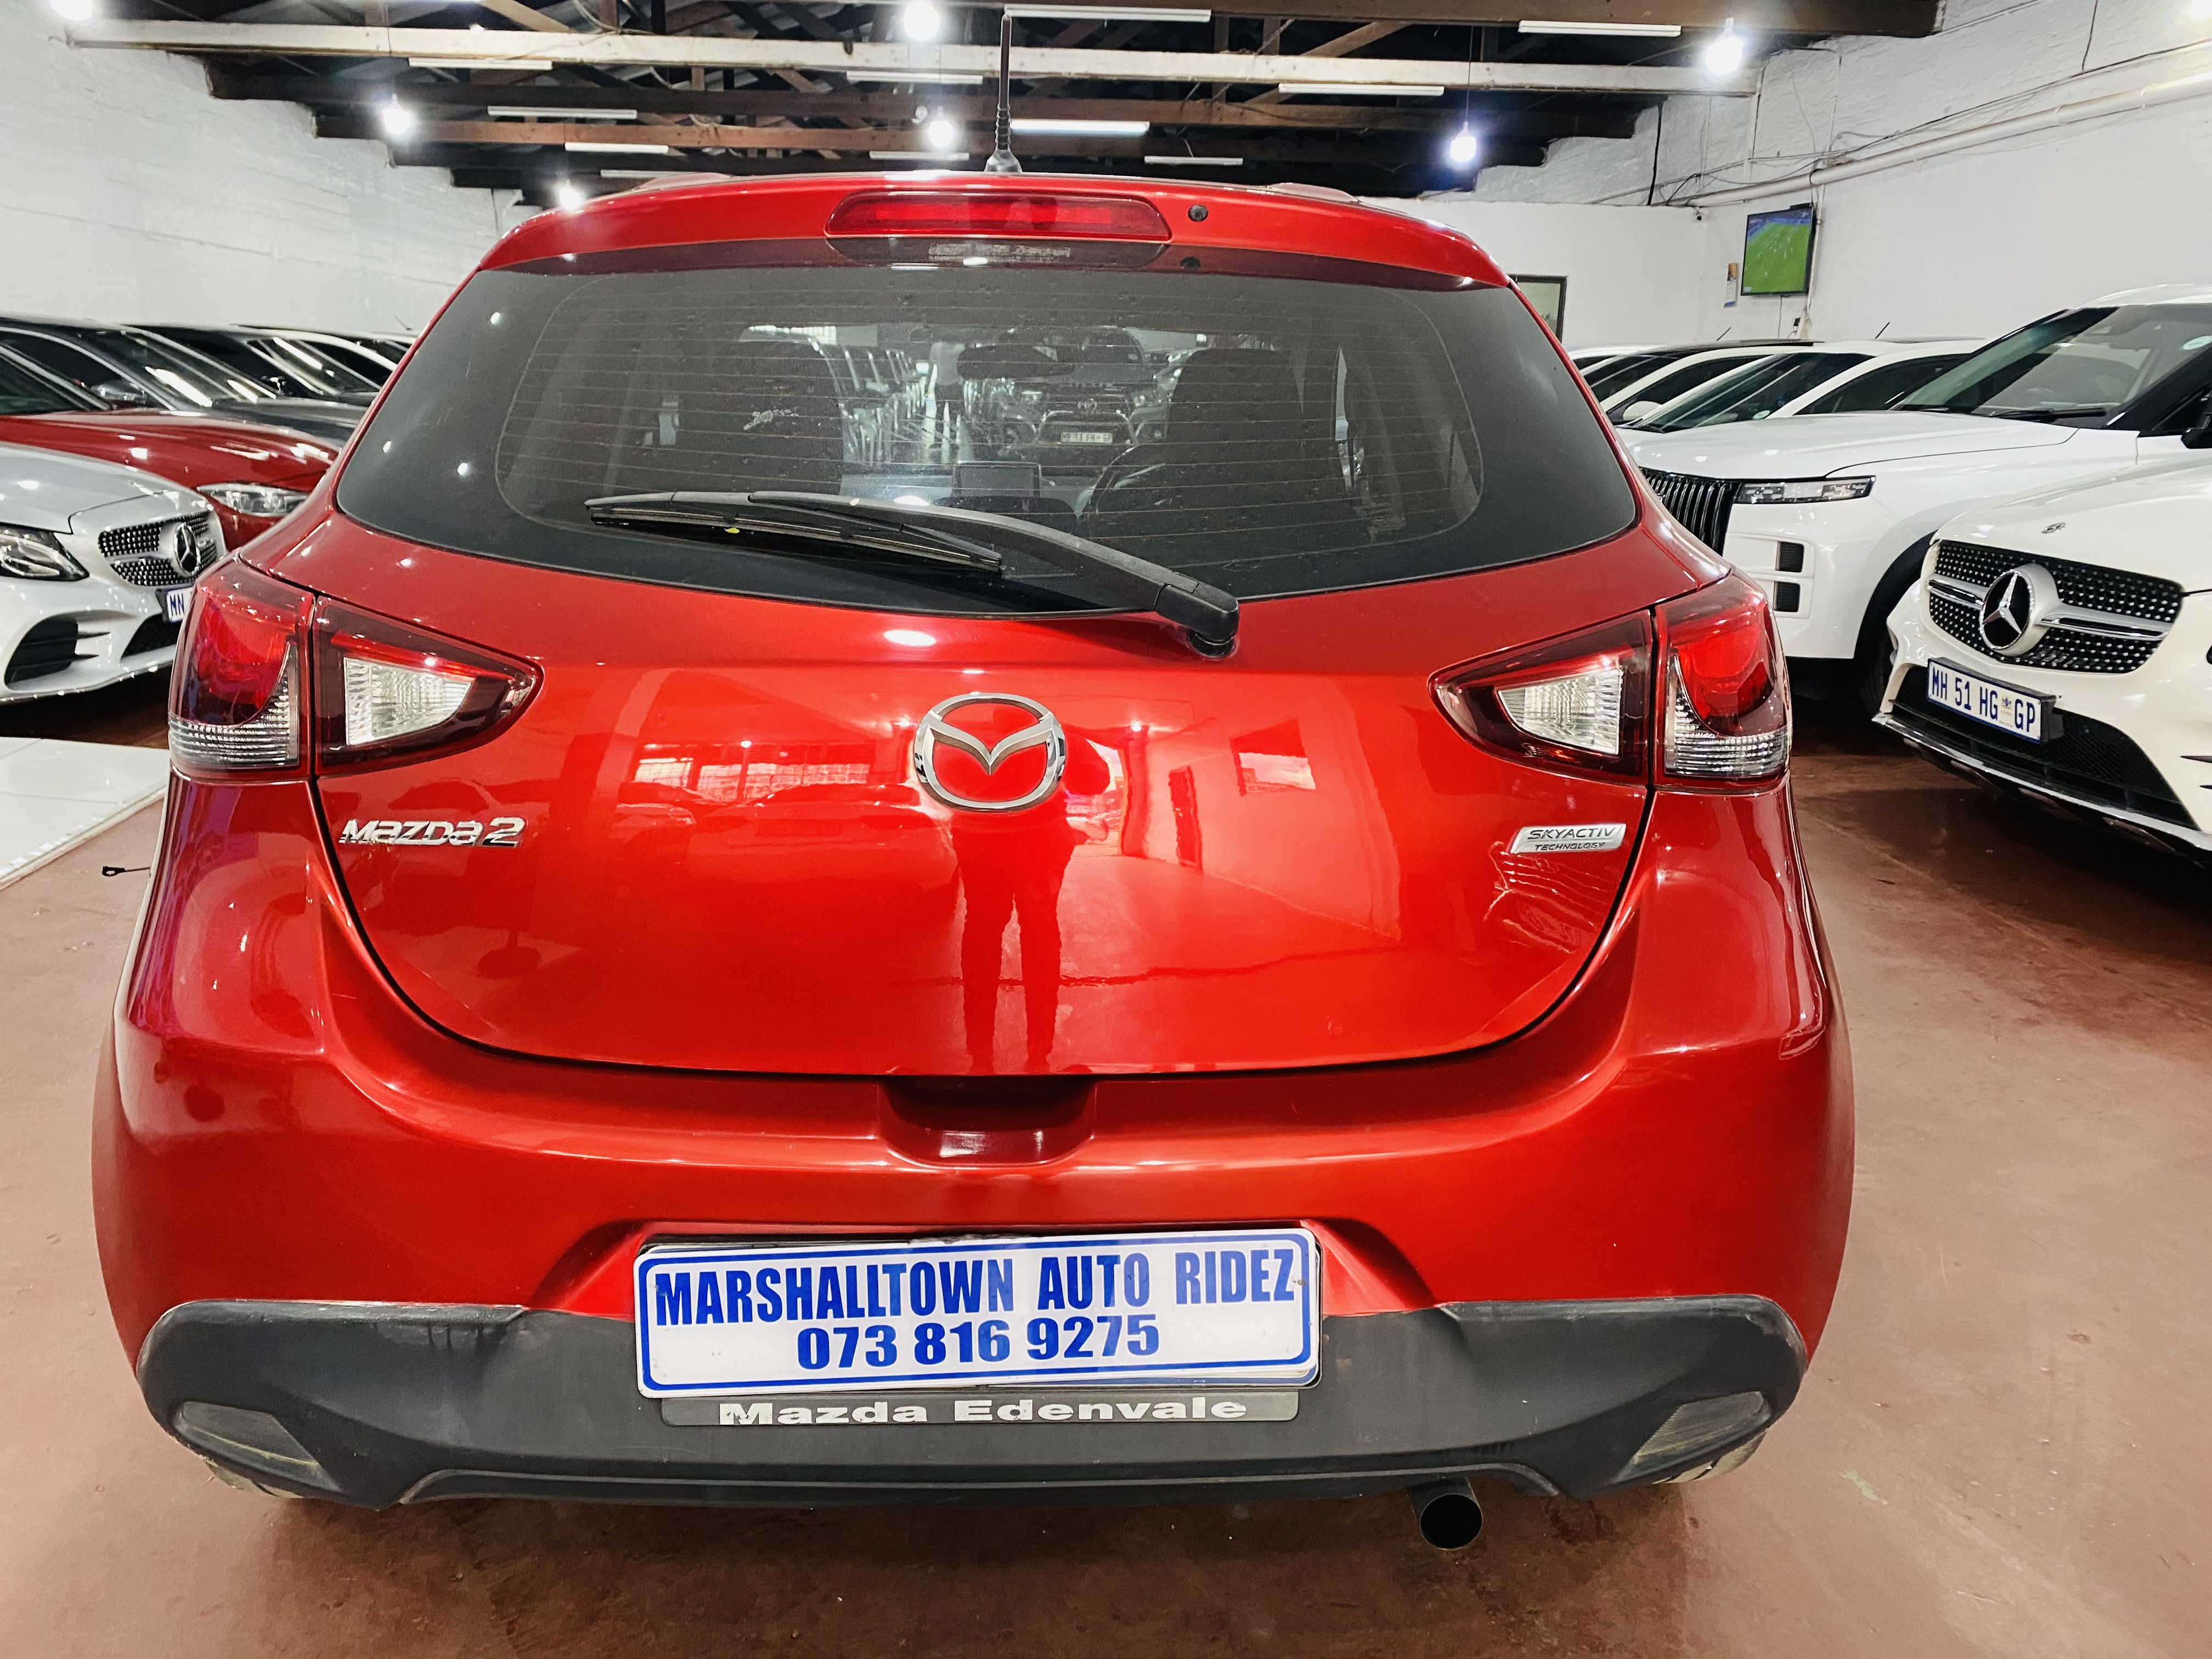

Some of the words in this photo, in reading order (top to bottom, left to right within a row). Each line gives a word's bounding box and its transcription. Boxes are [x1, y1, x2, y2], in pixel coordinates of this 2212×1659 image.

[170, 592, 184, 616] MN
[1932, 666, 1947, 701] MH
[1955, 677, 1971, 710] 51
[1979, 686, 1998, 721] HG
[2015, 698, 2035, 732] GP
[1527, 827, 1616, 840] SKYACTIV
[1535, 842, 1605, 851] TECHNOLOGY
[655, 1258, 1014, 1326] MARSHALLTOWN
[1037, 1252, 1150, 1311] AUTO
[1175, 1249, 1295, 1305] RIDEZ
[797, 1324, 898, 1370] 073
[914, 1319, 1011, 1365] 816
[1026, 1313, 1159, 1361] 9275
[719, 1401, 928, 1426] Mazda
[953, 1397, 1247, 1423] Edenvale
